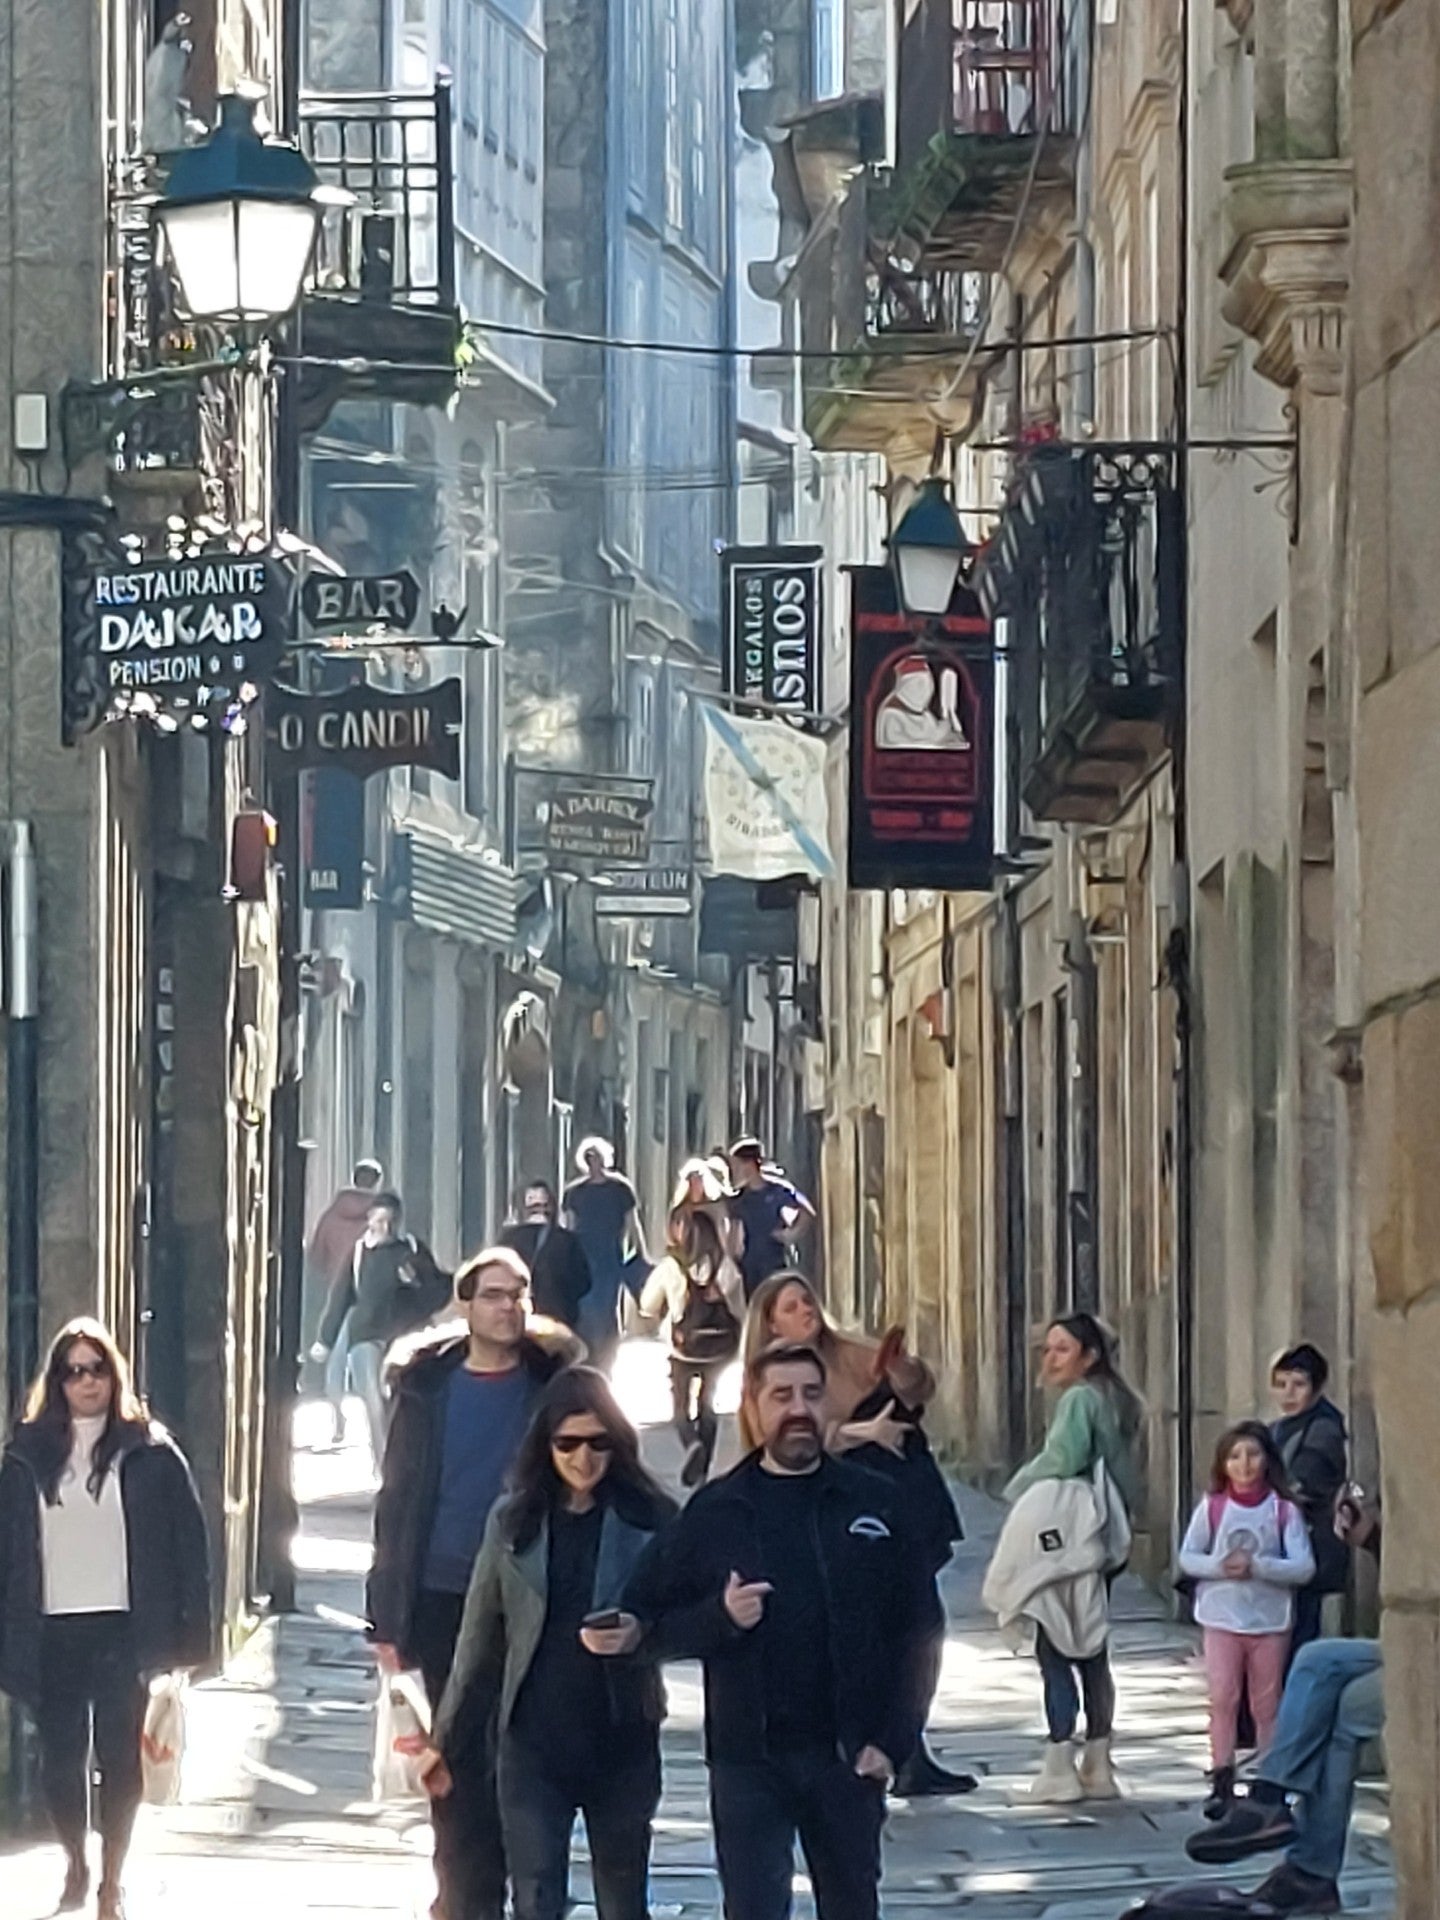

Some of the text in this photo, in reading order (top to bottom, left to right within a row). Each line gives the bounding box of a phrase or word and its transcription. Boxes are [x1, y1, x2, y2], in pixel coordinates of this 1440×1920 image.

[96, 563, 265, 604] RESTAURANTE
[316, 579, 406, 619] BAR
[100, 602, 263, 652] DAKAR
[279, 713, 304, 752] O
